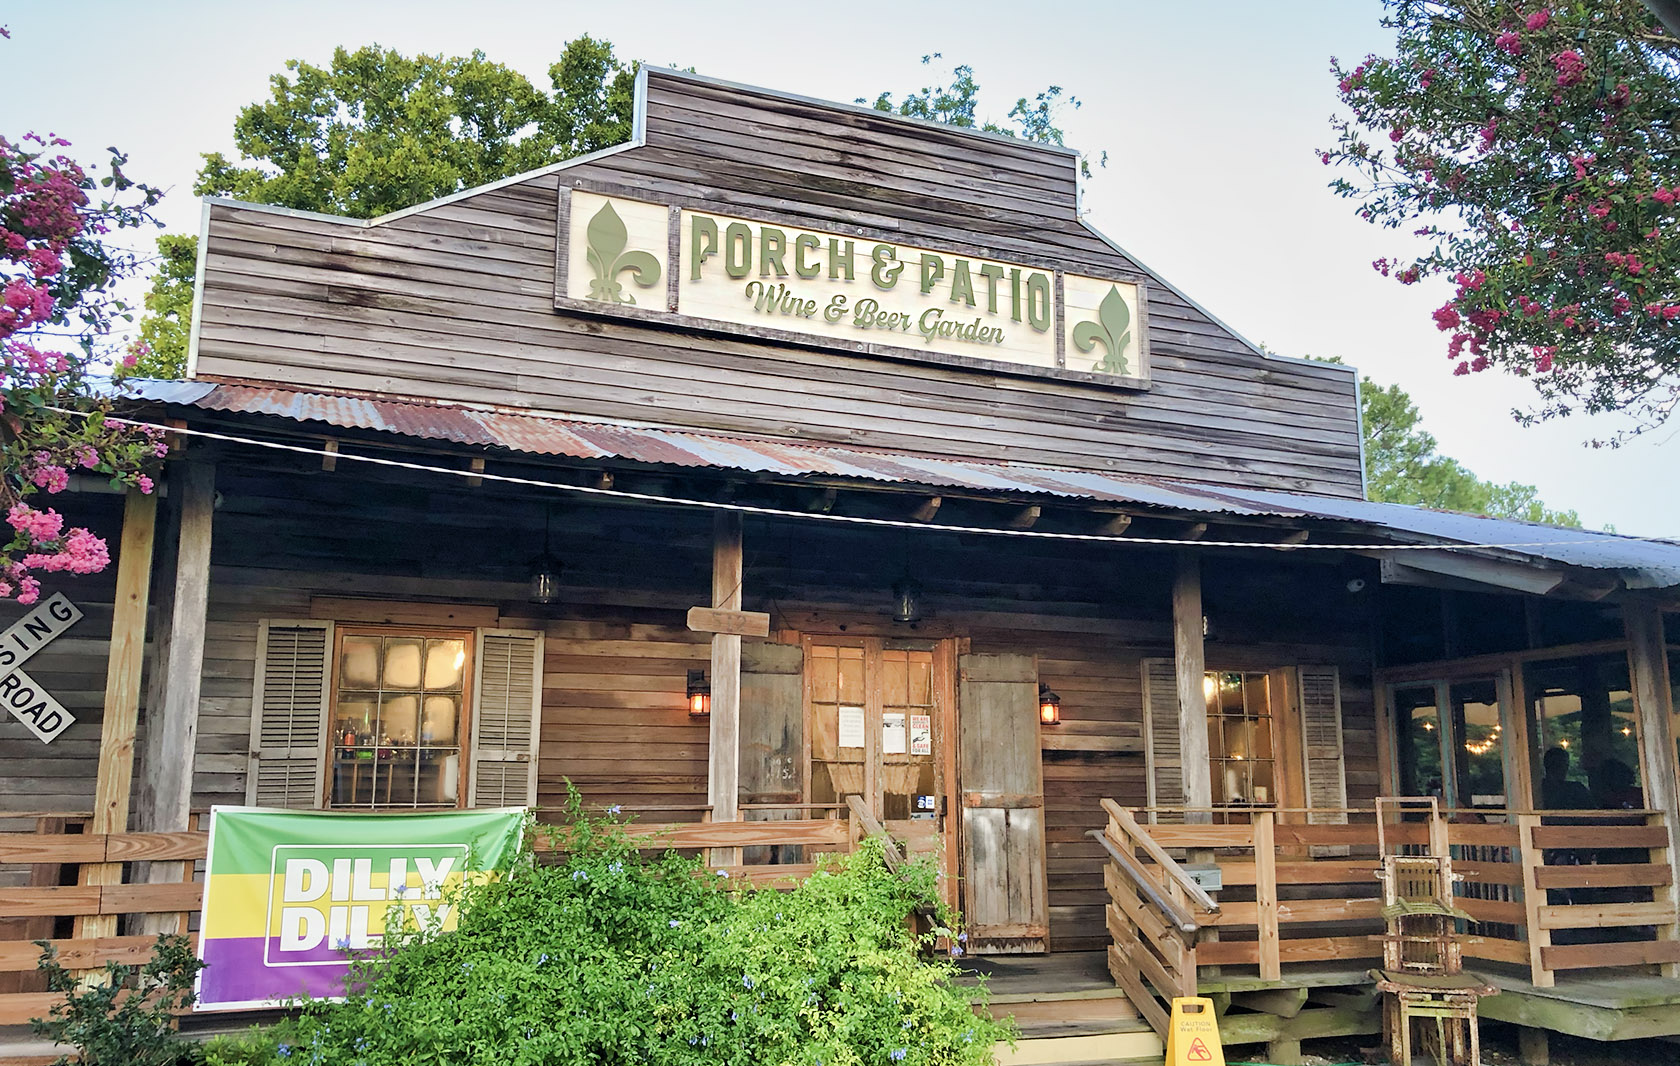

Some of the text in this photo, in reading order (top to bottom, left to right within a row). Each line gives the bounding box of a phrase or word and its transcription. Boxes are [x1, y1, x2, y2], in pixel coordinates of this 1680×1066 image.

[690, 215, 1051, 332] PORCH & PATIO
[745, 281, 1006, 344] Wine & Beer Garden
[0, 673, 63, 733] ROAD
[283, 857, 457, 902] DILLY
